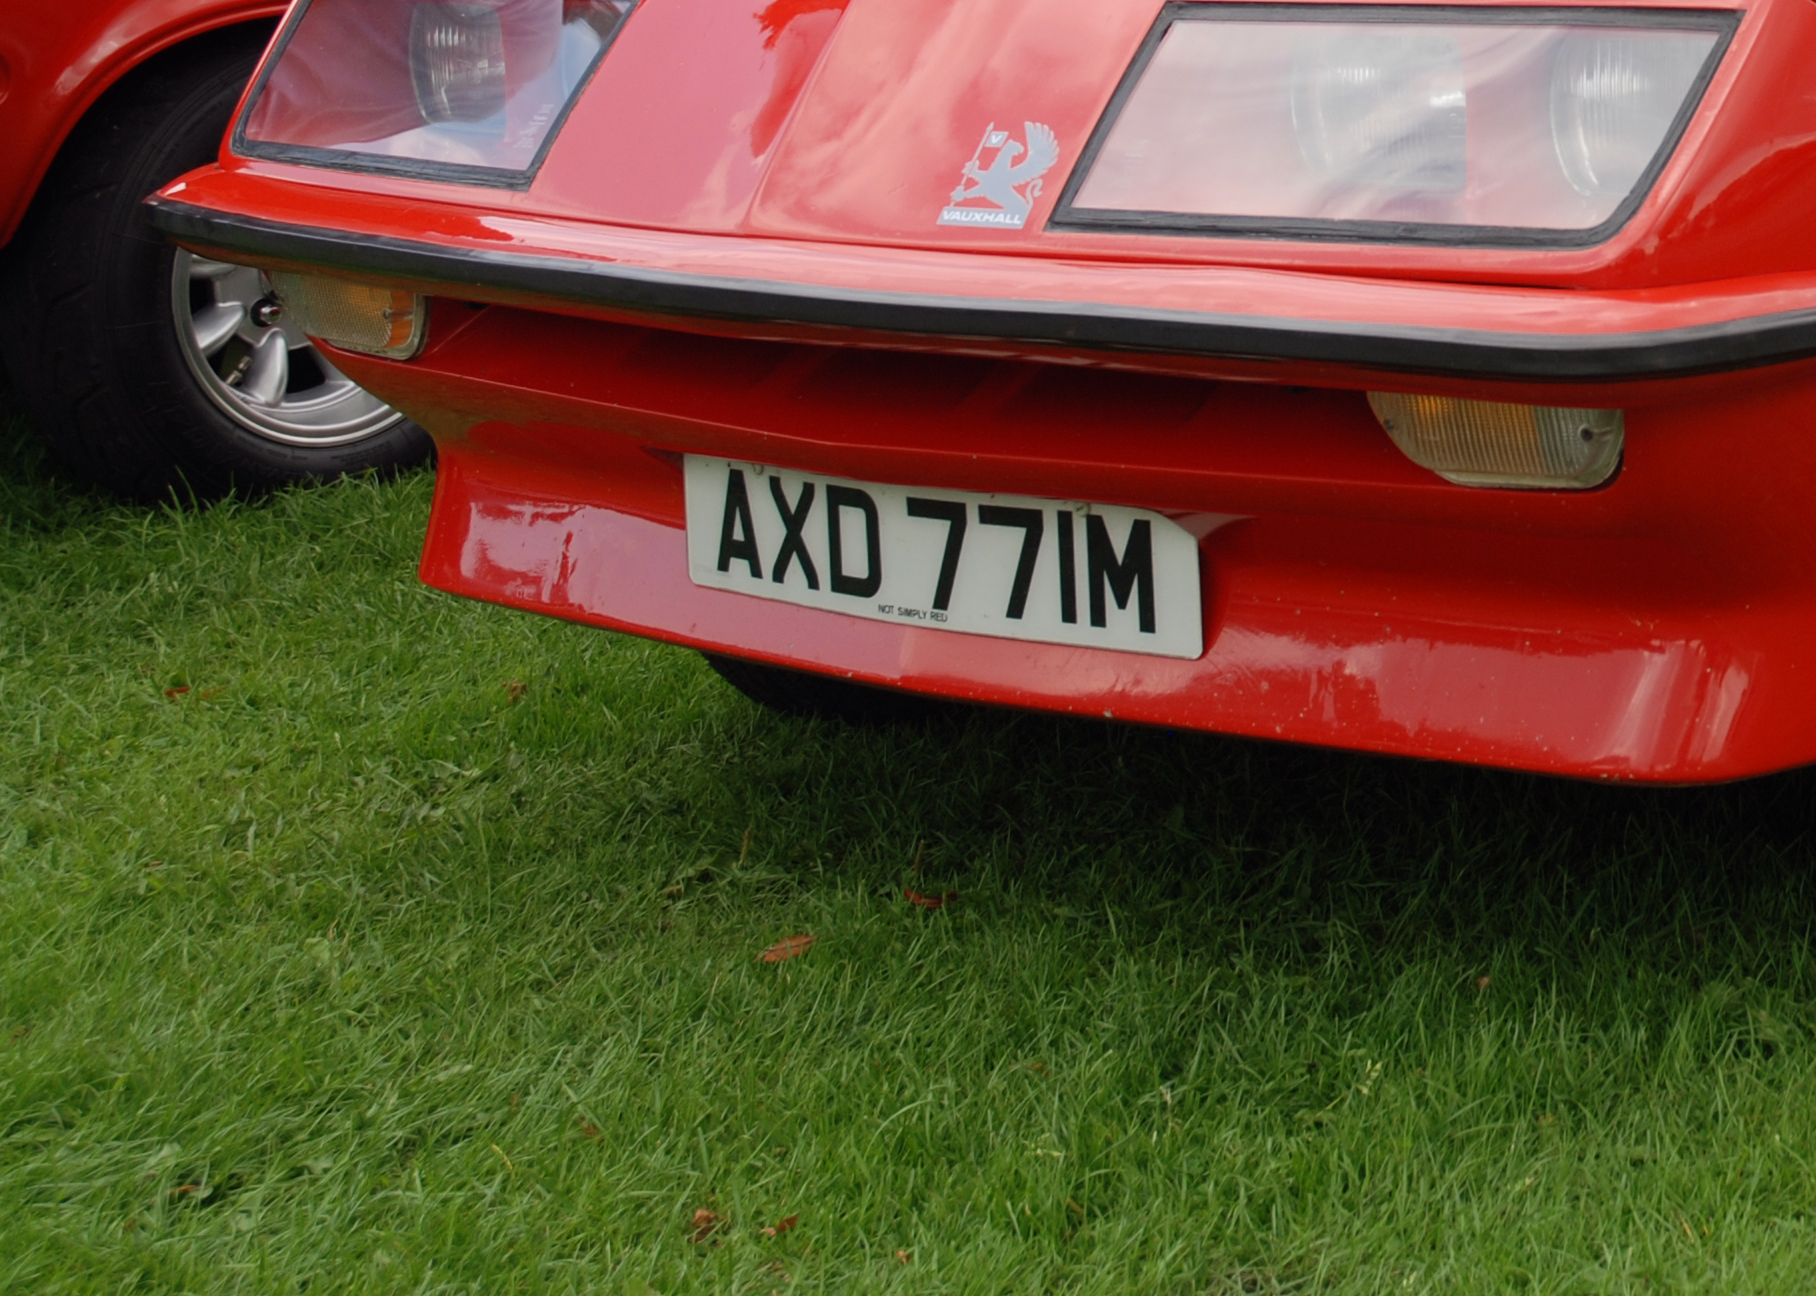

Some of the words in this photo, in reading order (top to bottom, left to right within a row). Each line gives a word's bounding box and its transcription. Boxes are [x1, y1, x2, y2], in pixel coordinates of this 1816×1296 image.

[990, 134, 1003, 144] V
[942, 210, 1022, 224] VAUXHALL
[716, 468, 882, 599] AXD
[906, 496, 1156, 634] 771M
[878, 604, 895, 615] NOT
[898, 607, 927, 620] SIMPLY
[930, 611, 948, 623] RED
